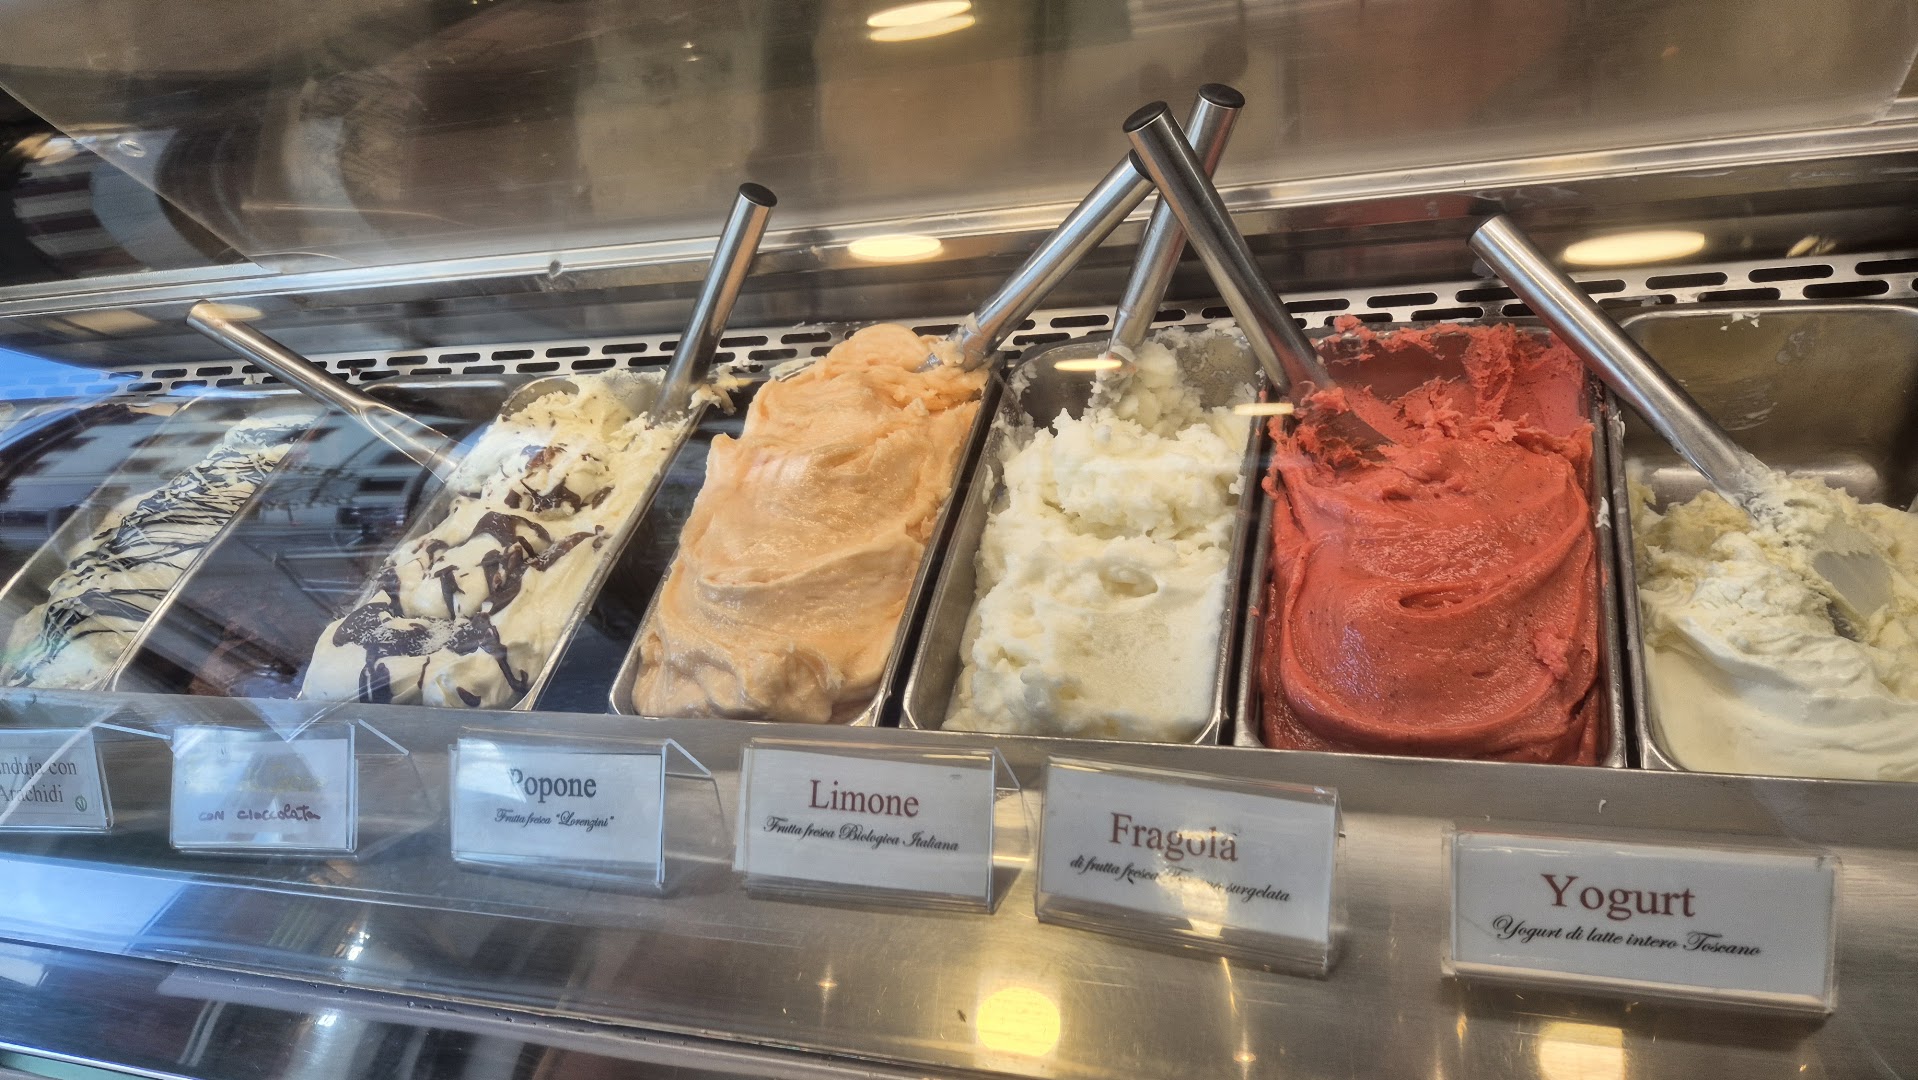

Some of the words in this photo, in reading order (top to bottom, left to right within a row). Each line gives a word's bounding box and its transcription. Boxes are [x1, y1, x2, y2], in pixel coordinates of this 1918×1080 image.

[0, 757, 44, 780] nduja
[49, 761, 77, 776] con
[494, 807, 526, 824] Frutta
[522, 812, 552, 828] fresca
[808, 779, 920, 818] Limone
[763, 815, 803, 836] Frutta
[800, 822, 835, 841] fresca
[838, 822, 900, 851] Biologica
[902, 831, 960, 852] Italiana
[1108, 811, 1239, 862] Fragola
[1069, 854, 1085, 869] di
[1082, 856, 1121, 875] frutta
[1119, 862, 1159, 883] fresca
[1225, 884, 1291, 903] surgelata
[1541, 872, 1696, 921] Yogurt
[1491, 914, 1563, 945] Yogurt
[1565, 924, 1584, 942] di
[1586, 926, 1623, 946] latte
[1625, 933, 1679, 951] intero
[1682, 931, 1762, 957] Toscano
